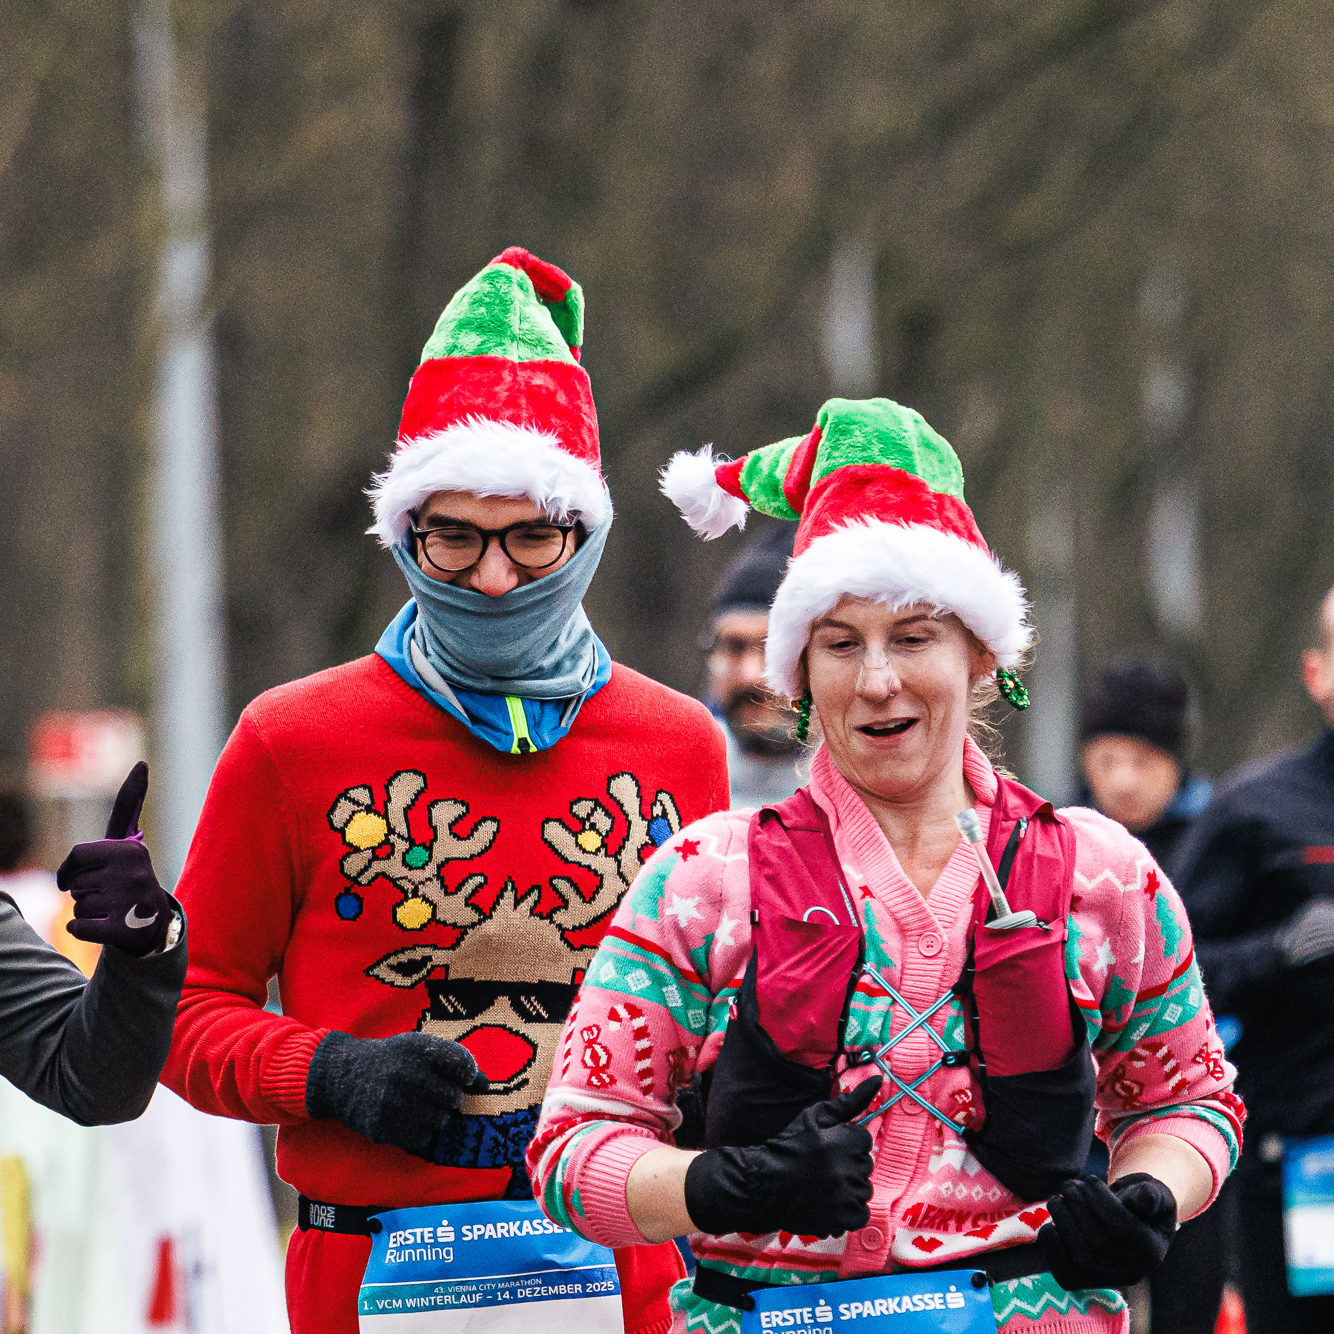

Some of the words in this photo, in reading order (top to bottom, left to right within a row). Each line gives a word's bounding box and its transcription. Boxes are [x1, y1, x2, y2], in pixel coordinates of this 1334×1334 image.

[388, 1227, 434, 1248] ERSTE
[384, 1245, 454, 1263] Running
[363, 1300, 373, 1310] 1.
[376, 1299, 403, 1310] VCM
[405, 1293, 483, 1308] WINTERLAUF
[496, 1290, 514, 1301] 14.
[517, 1284, 583, 1298] DEZEMBER
[586, 1281, 615, 1293] 2025
[447, 1284, 477, 1293] VIENNA
[478, 1283, 496, 1291] CITY
[498, 1278, 542, 1289] MARATHON
[760, 1307, 815, 1328] ERSTE
[838, 1293, 946, 1321] SPARKASSE
